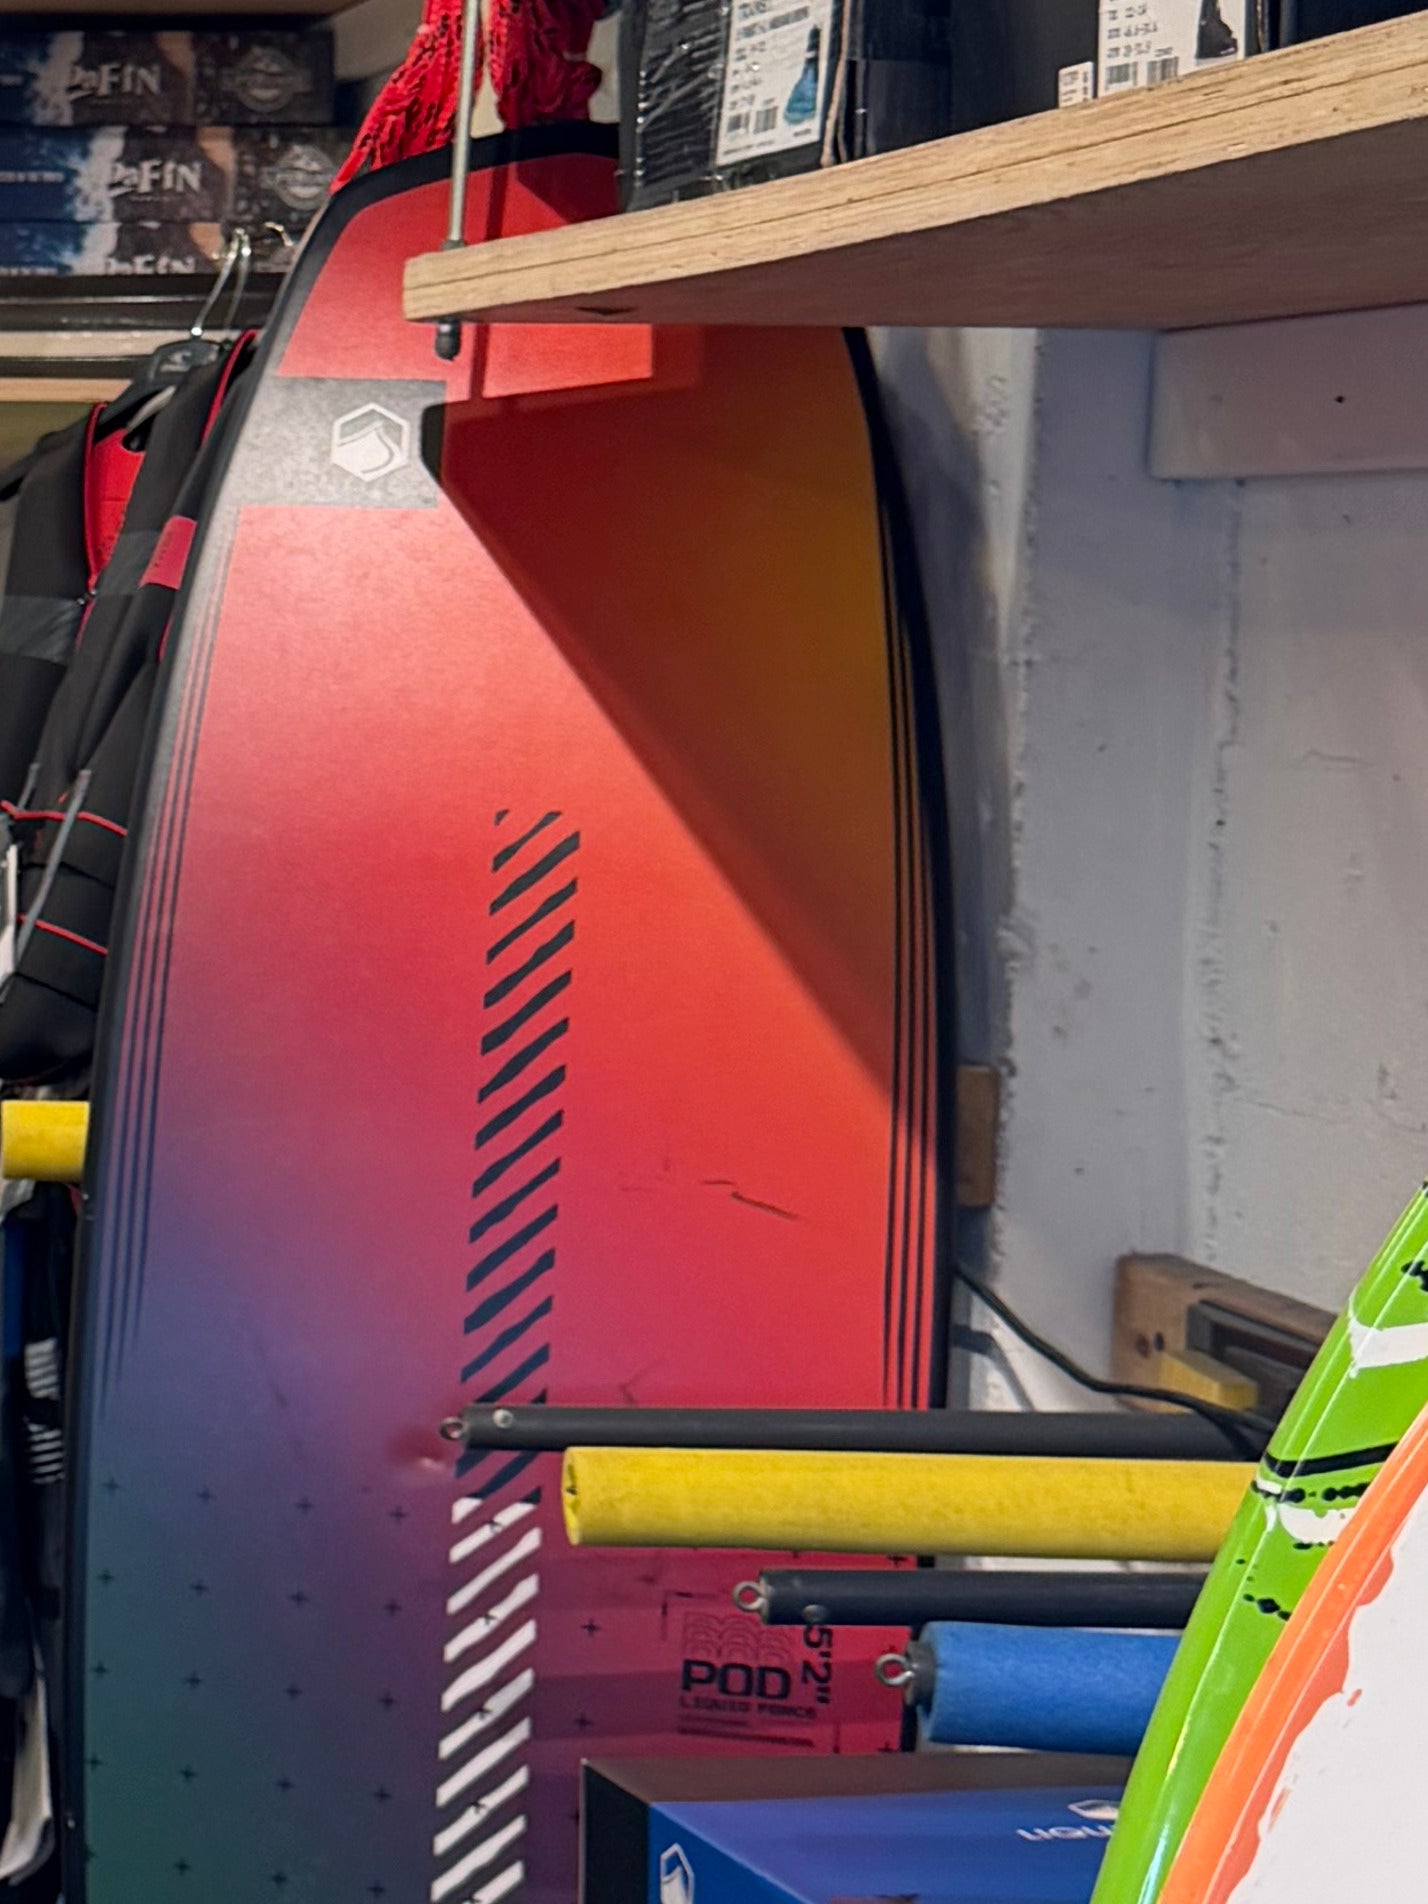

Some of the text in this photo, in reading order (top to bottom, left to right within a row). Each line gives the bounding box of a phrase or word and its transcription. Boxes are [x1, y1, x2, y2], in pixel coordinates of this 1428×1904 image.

[680, 1658, 792, 1700] POD
[679, 1696, 817, 1719] LIQUID FORCE
